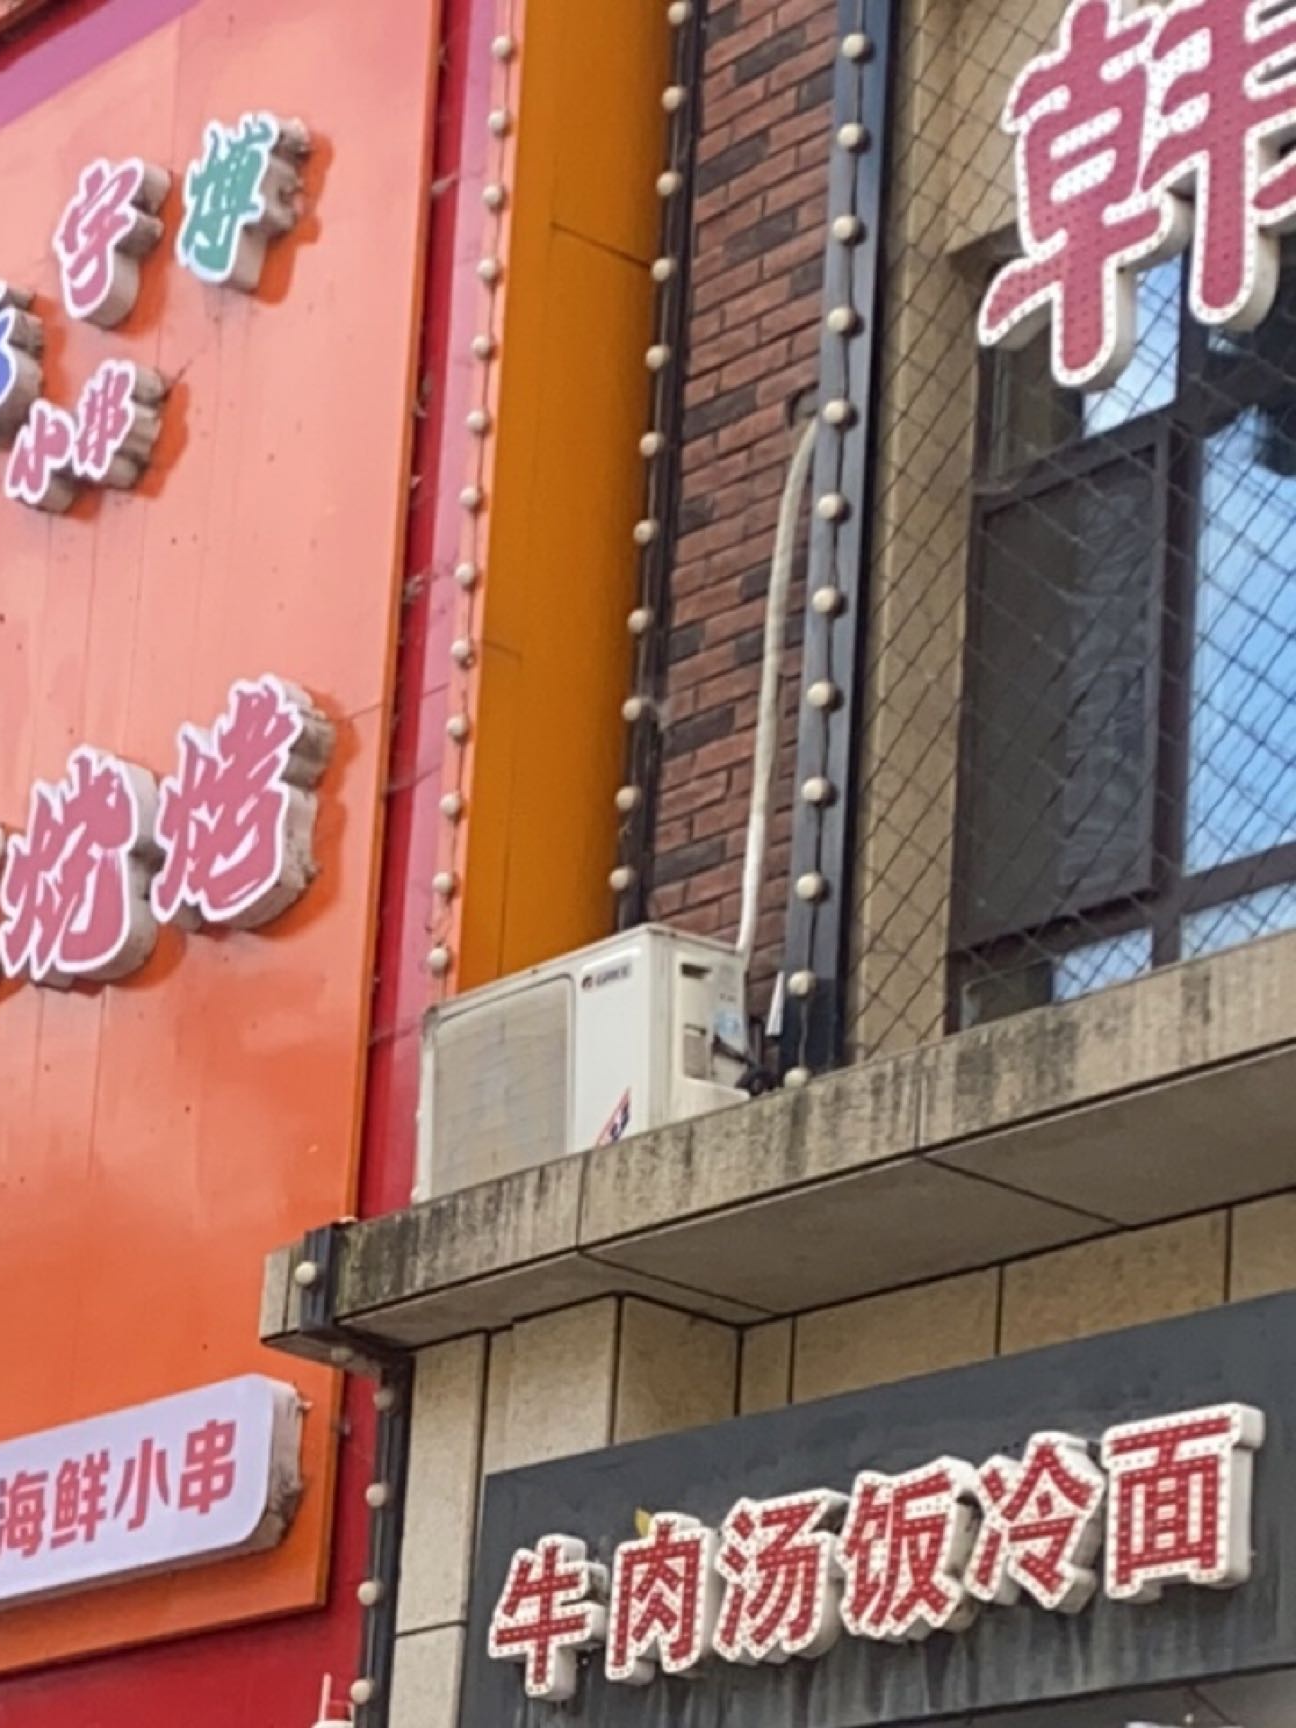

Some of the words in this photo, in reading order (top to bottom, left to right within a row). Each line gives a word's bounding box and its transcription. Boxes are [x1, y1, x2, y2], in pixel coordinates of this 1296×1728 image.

[4, 359, 136, 506] 小串
[488, 1401, 1265, 1701] 牛肉汤饭冷面
